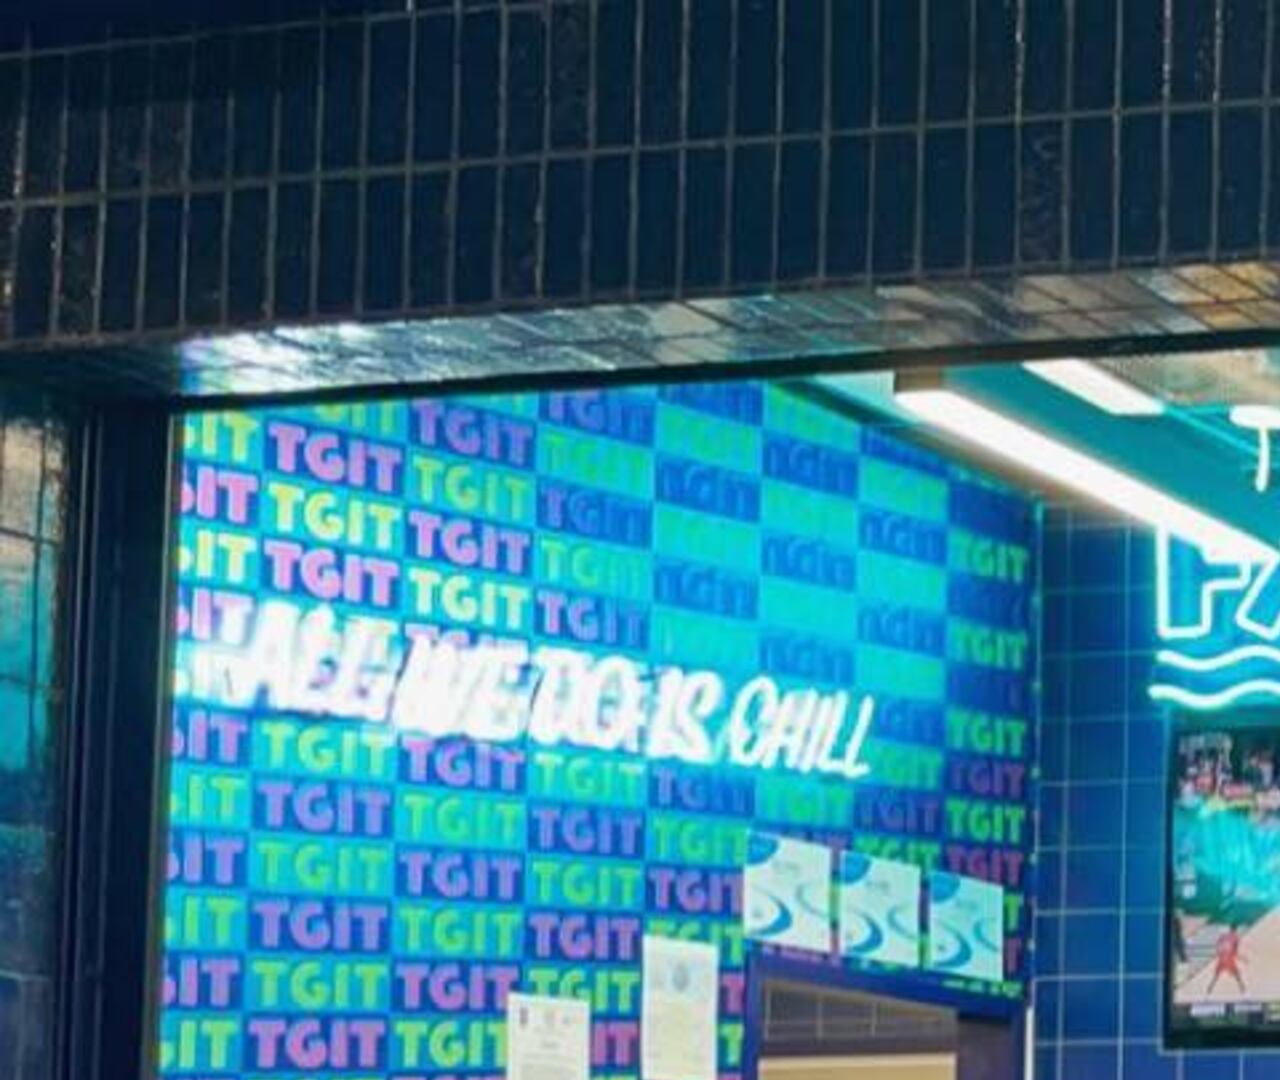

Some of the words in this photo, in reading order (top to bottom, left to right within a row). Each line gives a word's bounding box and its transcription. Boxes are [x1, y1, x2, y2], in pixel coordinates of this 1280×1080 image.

[267, 421, 402, 492] TGIT
[413, 457, 534, 521] TGIT
[267, 481, 400, 550] TGIT
[409, 509, 529, 573] TGIT
[263, 538, 399, 607] TGIT
[408, 567, 530, 630] TGIT
[539, 591, 645, 647] TGIT
[645, 665, 724, 765] IS
[728, 676, 875, 776] CHILL
[947, 706, 1026, 758] TGIT
[257, 780, 390, 834] TGIT
[403, 794, 525, 843] TGIT
[534, 809, 643, 853] TGIT
[260, 720, 397, 777] TGIT
[534, 753, 643, 799] TGIT
[947, 798, 1025, 844] TGIT
[255, 841, 390, 890] TGIT
[402, 853, 522, 900] TGIT
[534, 862, 641, 905] TGIT
[253, 900, 388, 950] TGIT
[400, 906, 522, 957] TGIT
[529, 914, 640, 959] TGIT
[251, 959, 389, 1008] TGIT
[249, 1018, 386, 1069] TGIT
